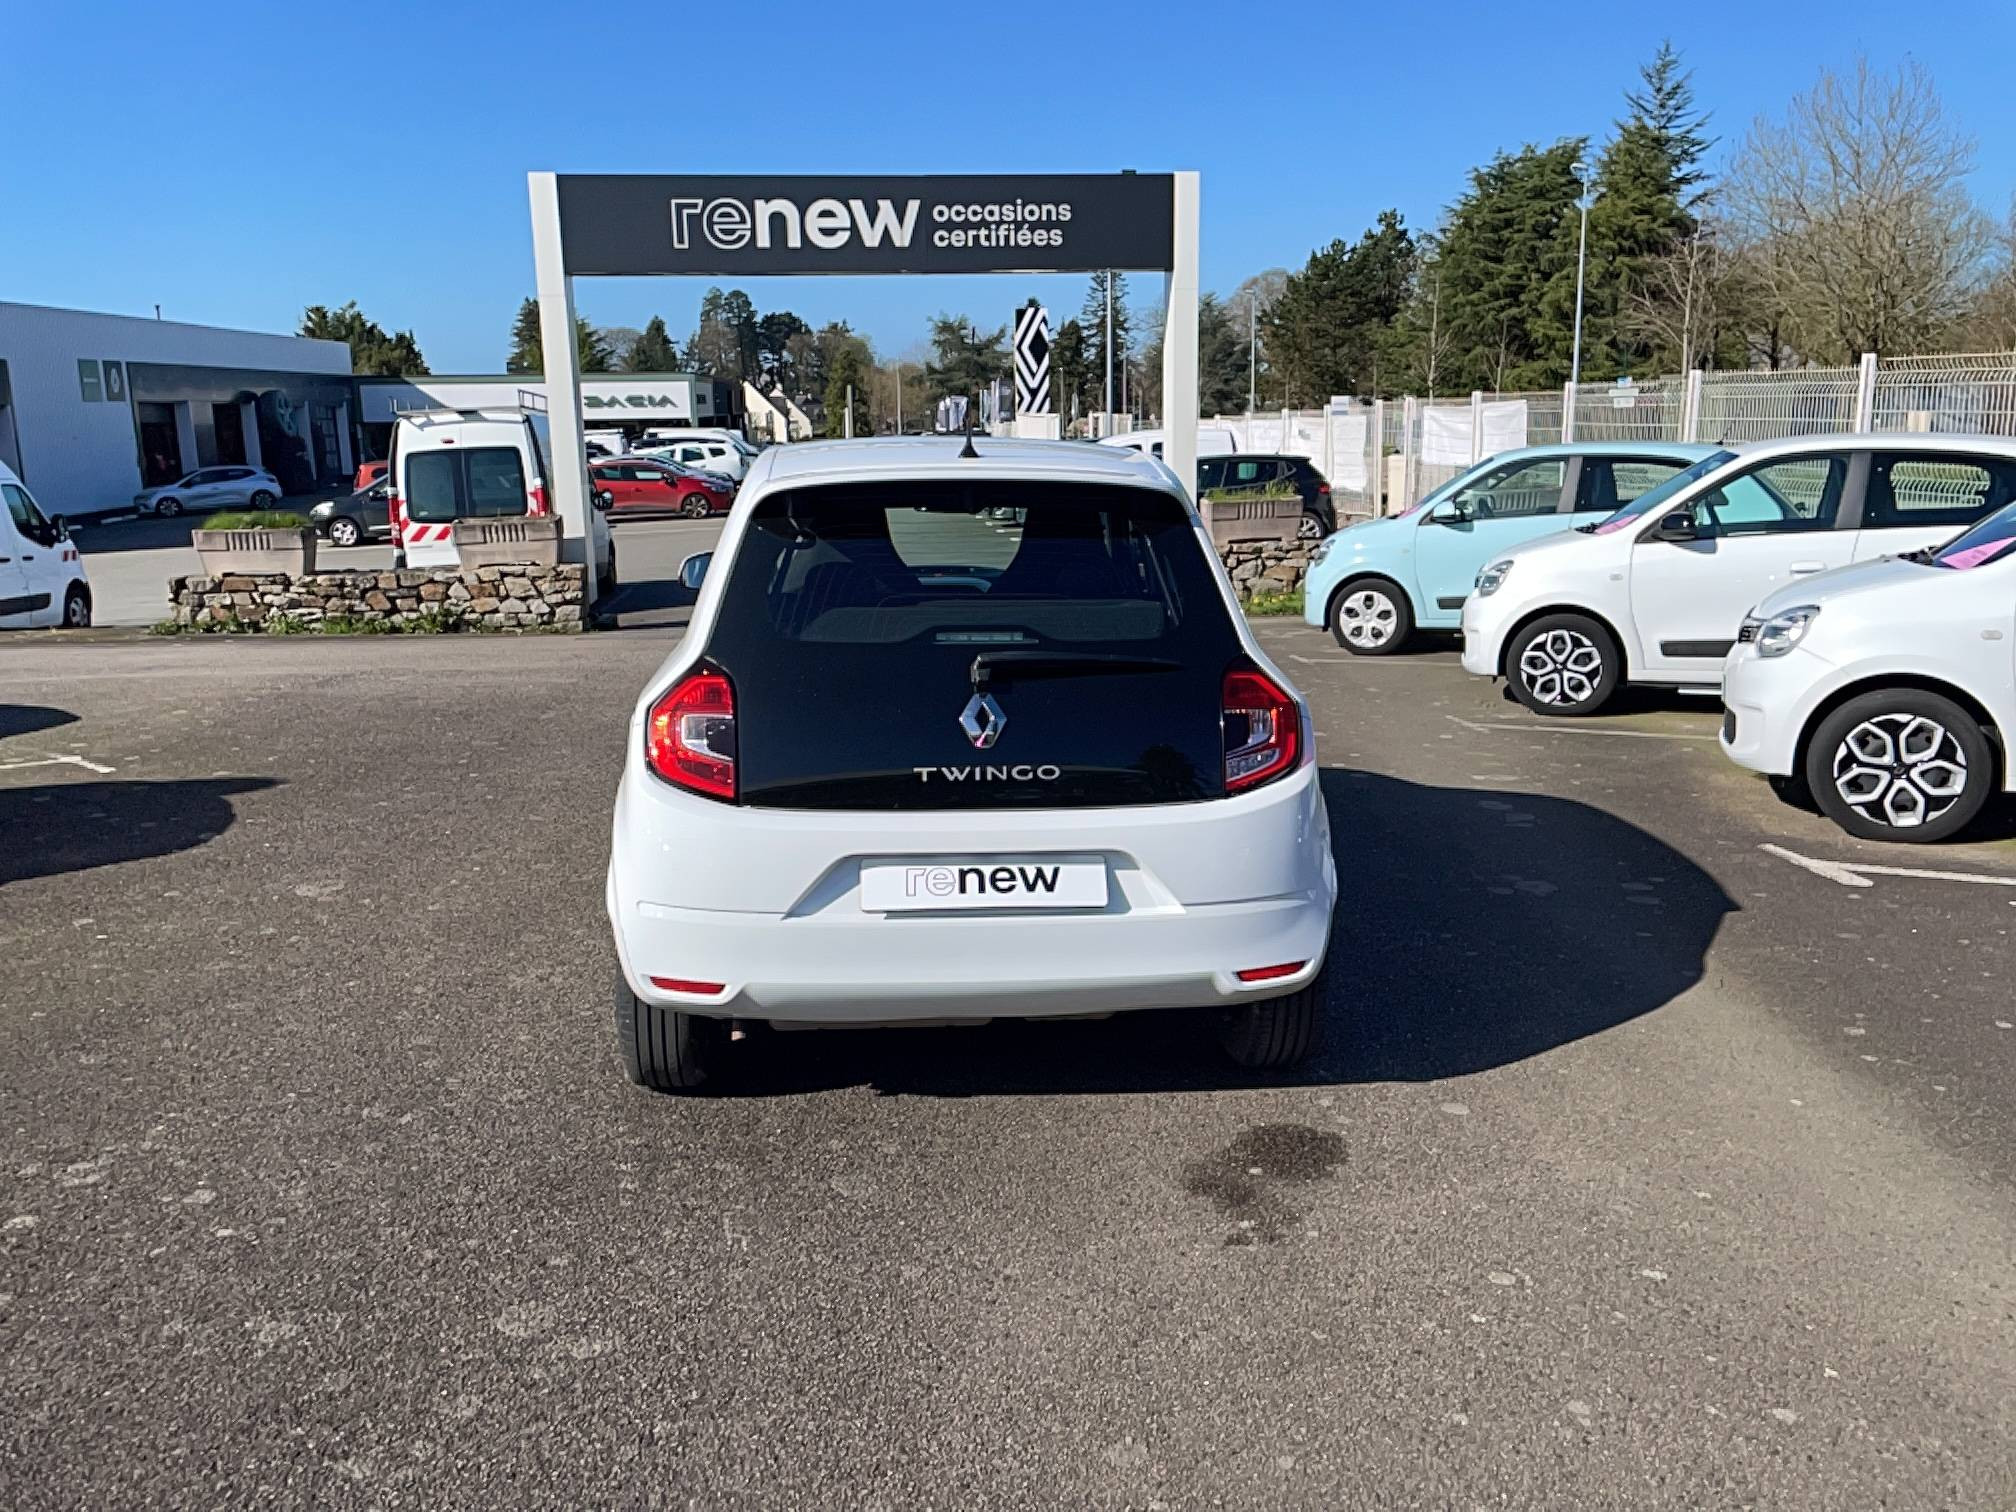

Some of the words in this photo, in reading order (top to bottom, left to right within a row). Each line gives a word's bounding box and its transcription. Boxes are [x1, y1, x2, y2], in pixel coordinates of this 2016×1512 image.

[670, 197, 921, 249] renew
[932, 198, 1072, 223] occasions
[932, 223, 1064, 248] certifiées
[913, 765, 1060, 782] TWINGO
[905, 865, 1060, 896] renew
